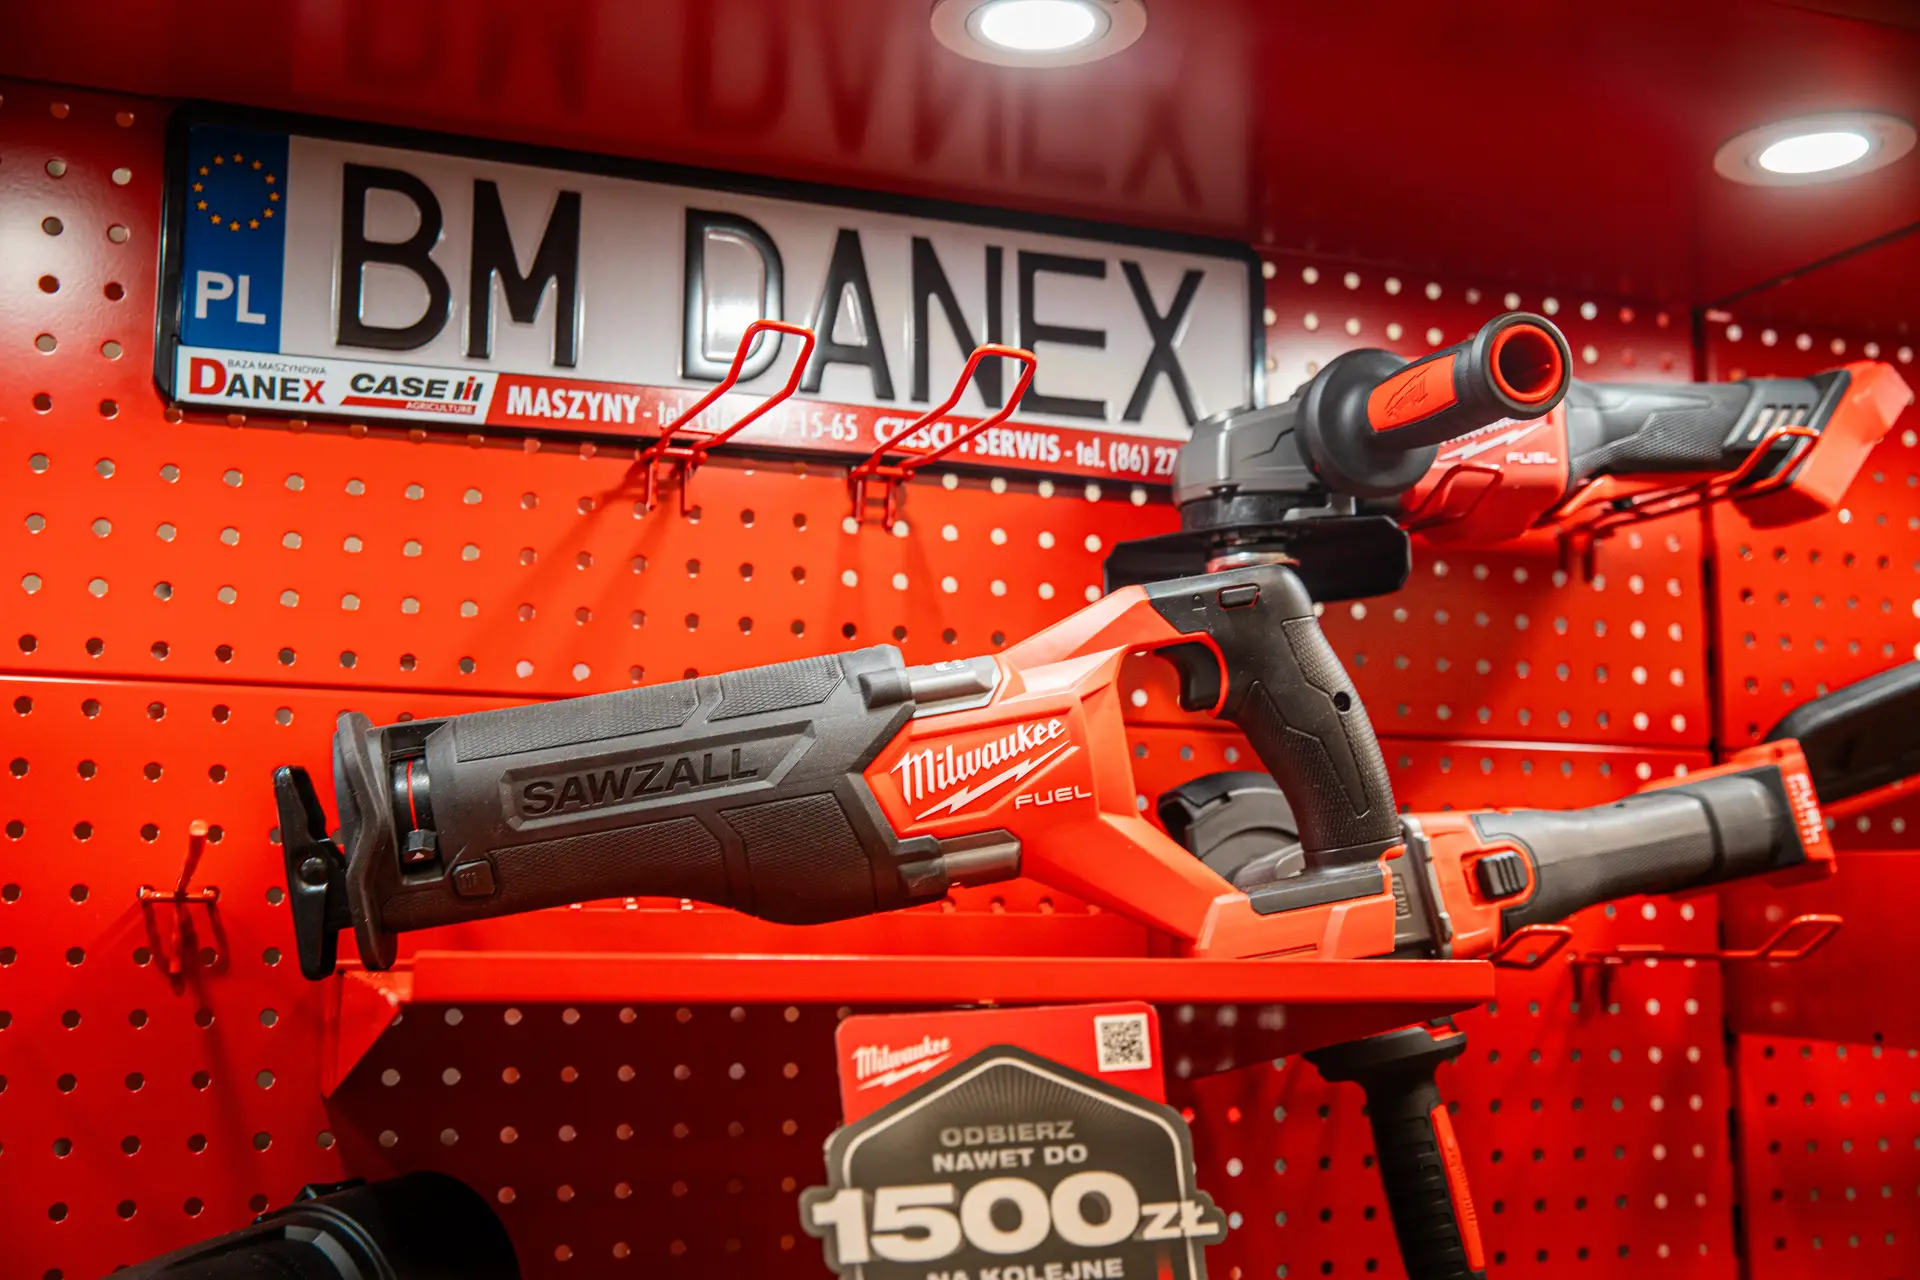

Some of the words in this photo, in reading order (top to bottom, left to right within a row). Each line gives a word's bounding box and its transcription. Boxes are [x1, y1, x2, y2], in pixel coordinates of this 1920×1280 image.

[194, 269, 267, 325] PL
[335, 162, 583, 368] BM
[680, 207, 1205, 427] DANEX
[188, 356, 326, 404] DANEX
[227, 359, 256, 369] BAZA
[350, 373, 449, 400] CASE
[506, 384, 641, 425] MASZYNY
[405, 401, 474, 414] AGRICULTURE
[974, 426, 1061, 463] SERWIS
[1075, 436, 1106, 468] tel.
[1108, 440, 1150, 477] (86)
[890, 718, 1066, 807] Milwaukee
[523, 748, 759, 818] SAWZALL
[1015, 785, 1092, 810] FUEL
[939, 1120, 1075, 1148] ODBIERZ
[932, 1147, 1034, 1174] NAWET
[1043, 1143, 1088, 1165] DO
[979, 1257, 1125, 1280] KOLEJNE
